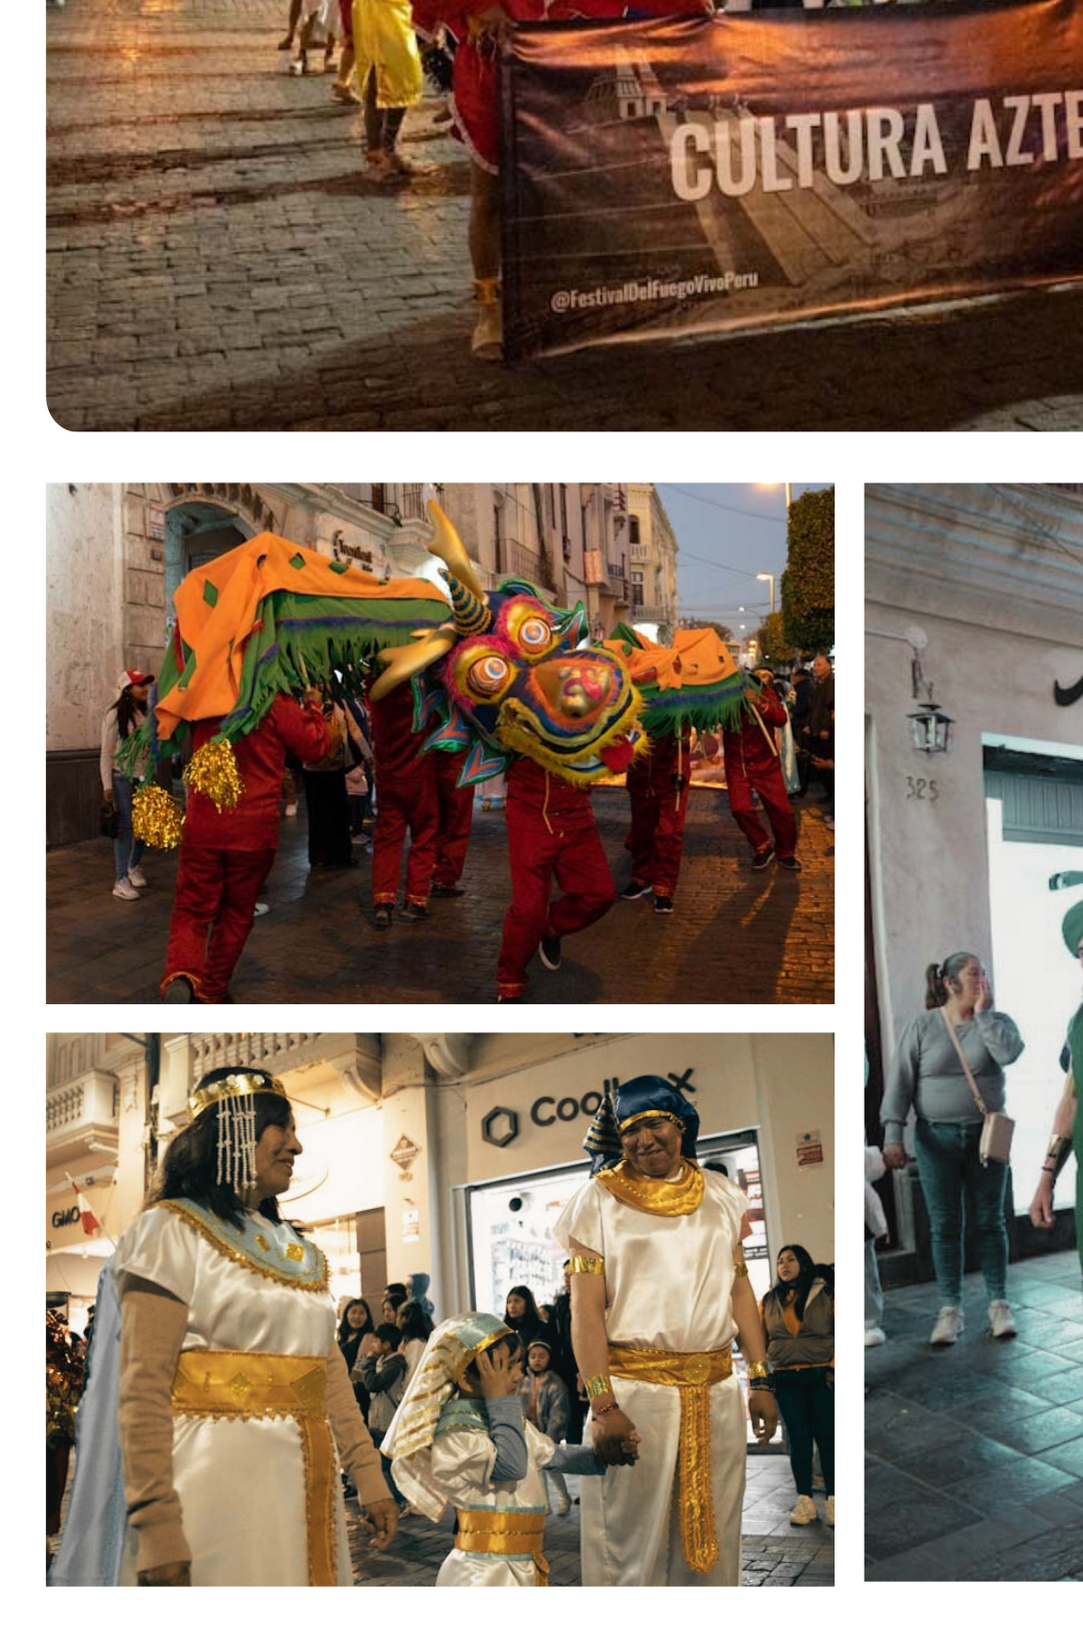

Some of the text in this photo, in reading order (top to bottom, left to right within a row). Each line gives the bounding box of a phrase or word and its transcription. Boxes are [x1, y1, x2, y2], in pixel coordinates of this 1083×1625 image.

[669, 102, 947, 202] CULTURA
[551, 272, 758, 312] @FestivalDelFuegoVivoPeru
[906, 776, 939, 802] 325
[530, 1068, 696, 1127] Coolx
